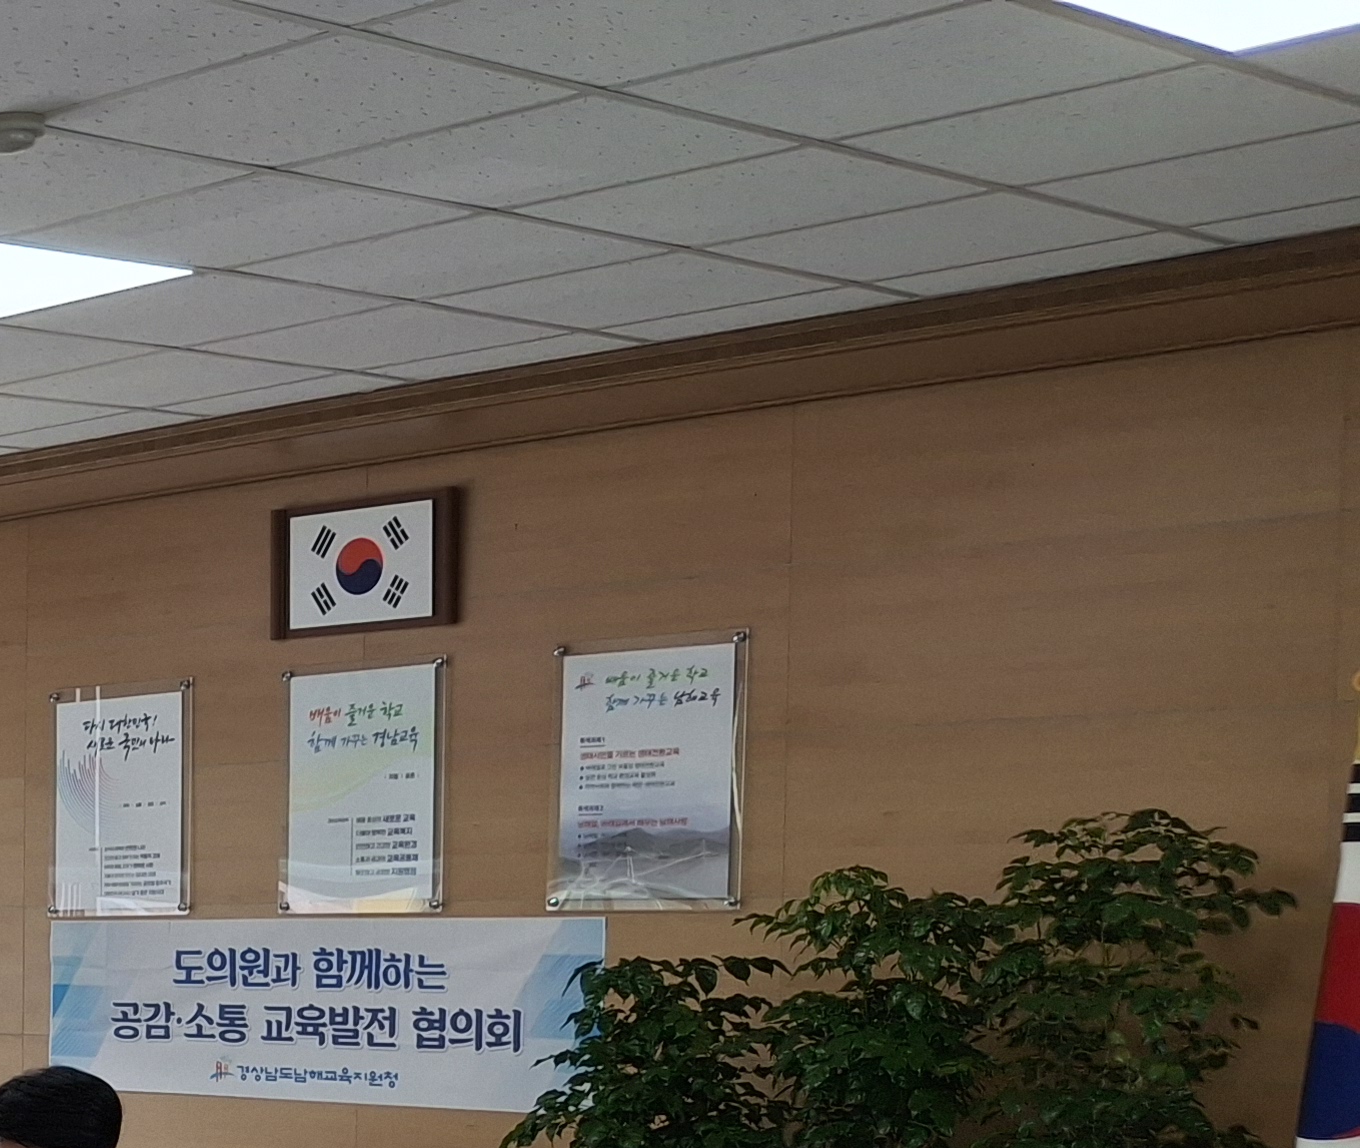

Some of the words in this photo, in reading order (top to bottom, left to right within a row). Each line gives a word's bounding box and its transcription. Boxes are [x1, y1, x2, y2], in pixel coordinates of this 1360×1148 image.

[309, 705, 341, 727] 배움이
[345, 703, 376, 727] 즐거운
[380, 701, 403, 720] 학교
[307, 730, 338, 754] 함께
[341, 734, 368, 749] 가꾸는
[372, 726, 420, 753] 경남교육
[172, 946, 302, 989] 도의원과
[311, 946, 449, 991] 함께하는
[110, 1001, 249, 1044] 공감·소통
[260, 1003, 398, 1049] 교육발전
[411, 1006, 524, 1053] 협의회
[236, 1064, 399, 1089] 경상남도남해교육지원청
